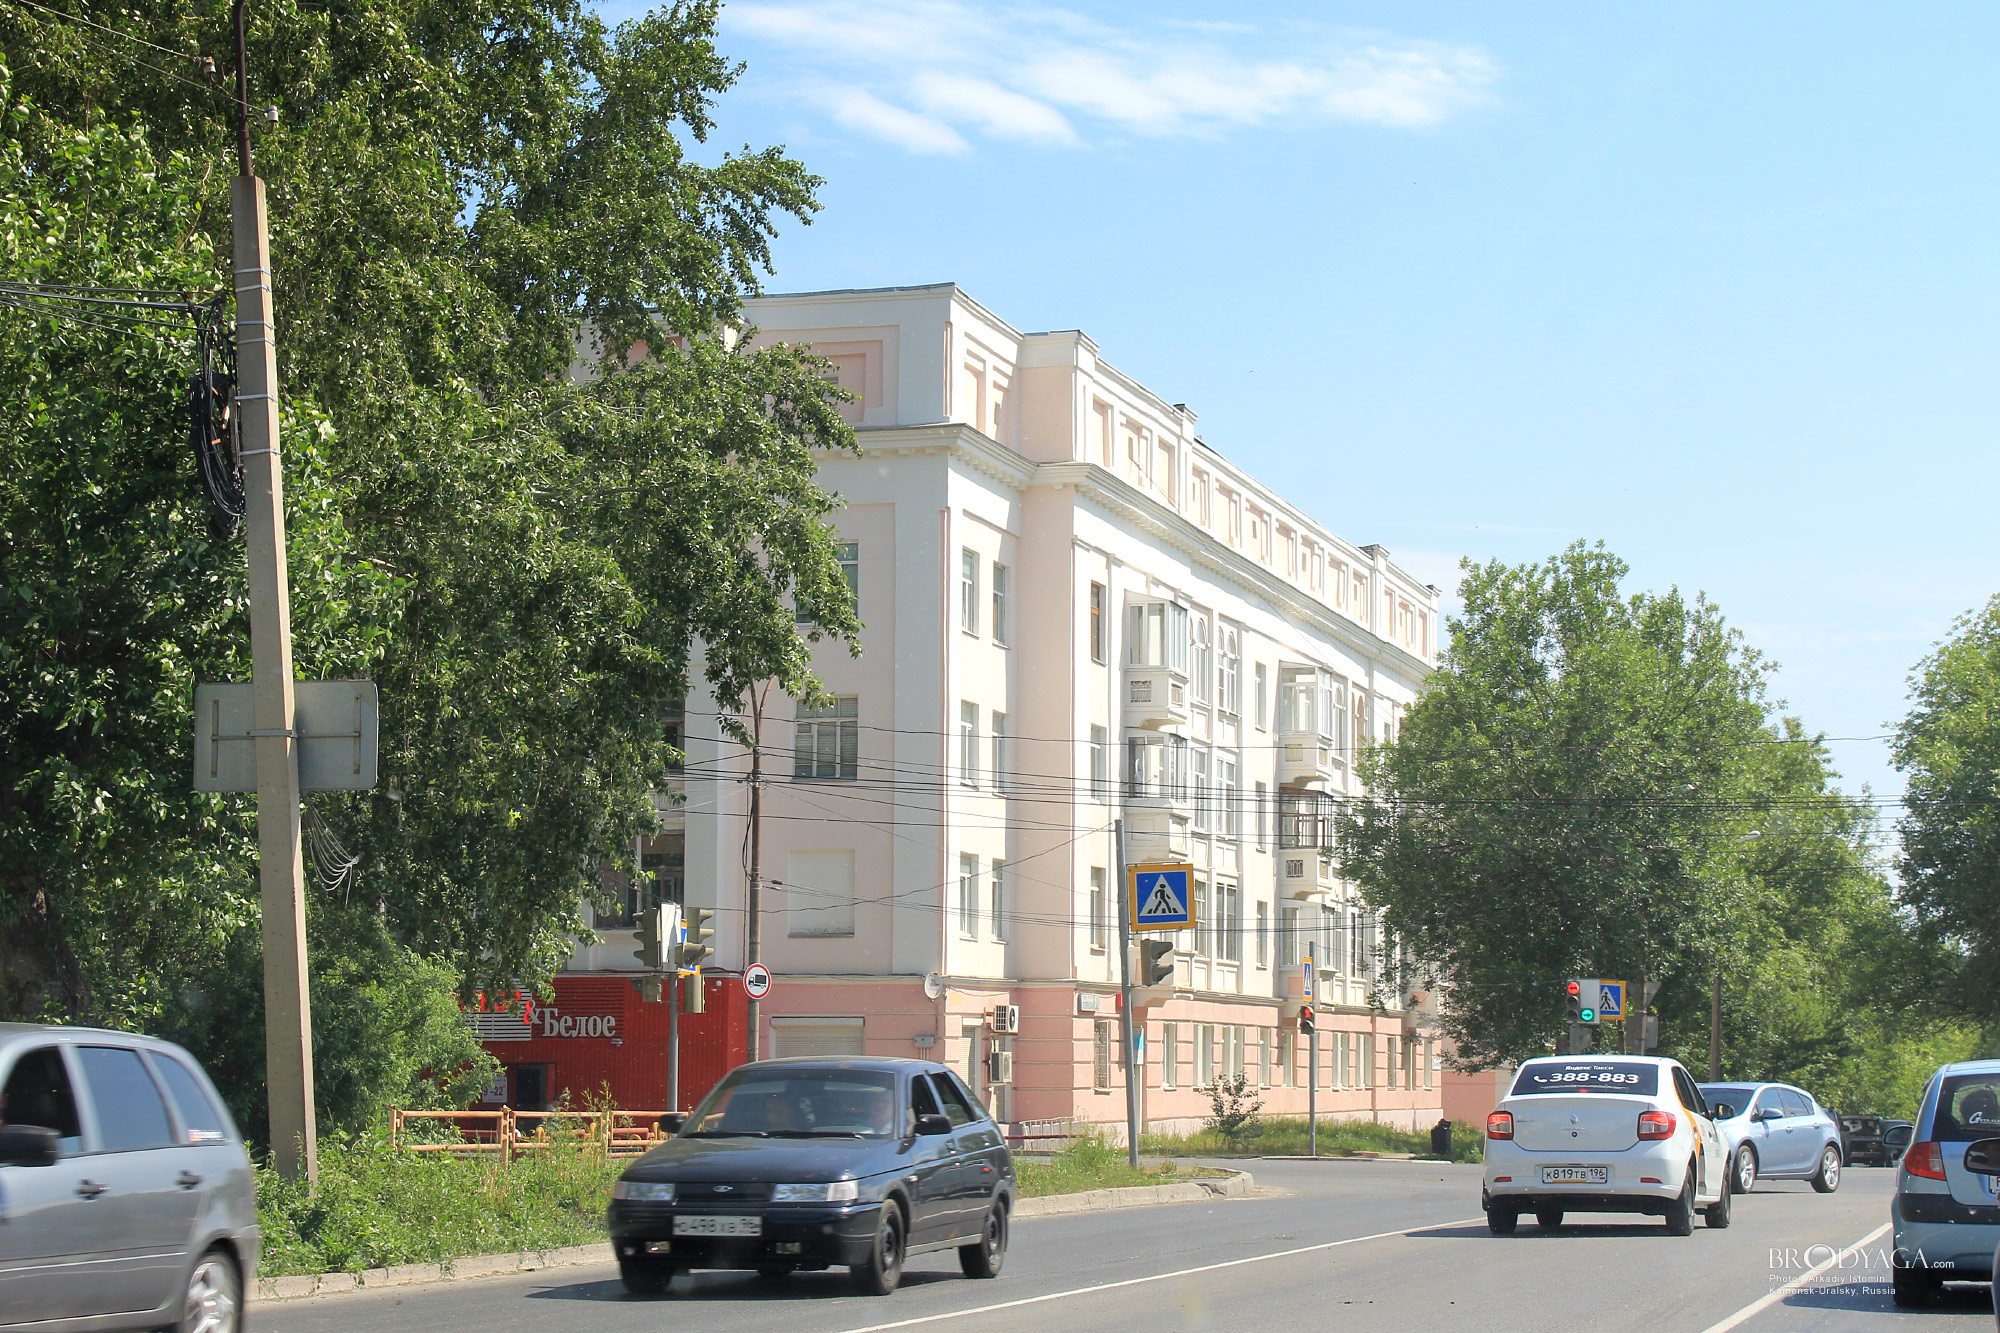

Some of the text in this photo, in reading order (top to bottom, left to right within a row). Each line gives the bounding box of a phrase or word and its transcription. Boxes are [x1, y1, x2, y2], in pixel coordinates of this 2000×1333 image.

[542, 1007, 616, 1038] Белое
[1549, 1072, 1639, 1084] 388-883
[1589, 1168, 1605, 1177] 196
